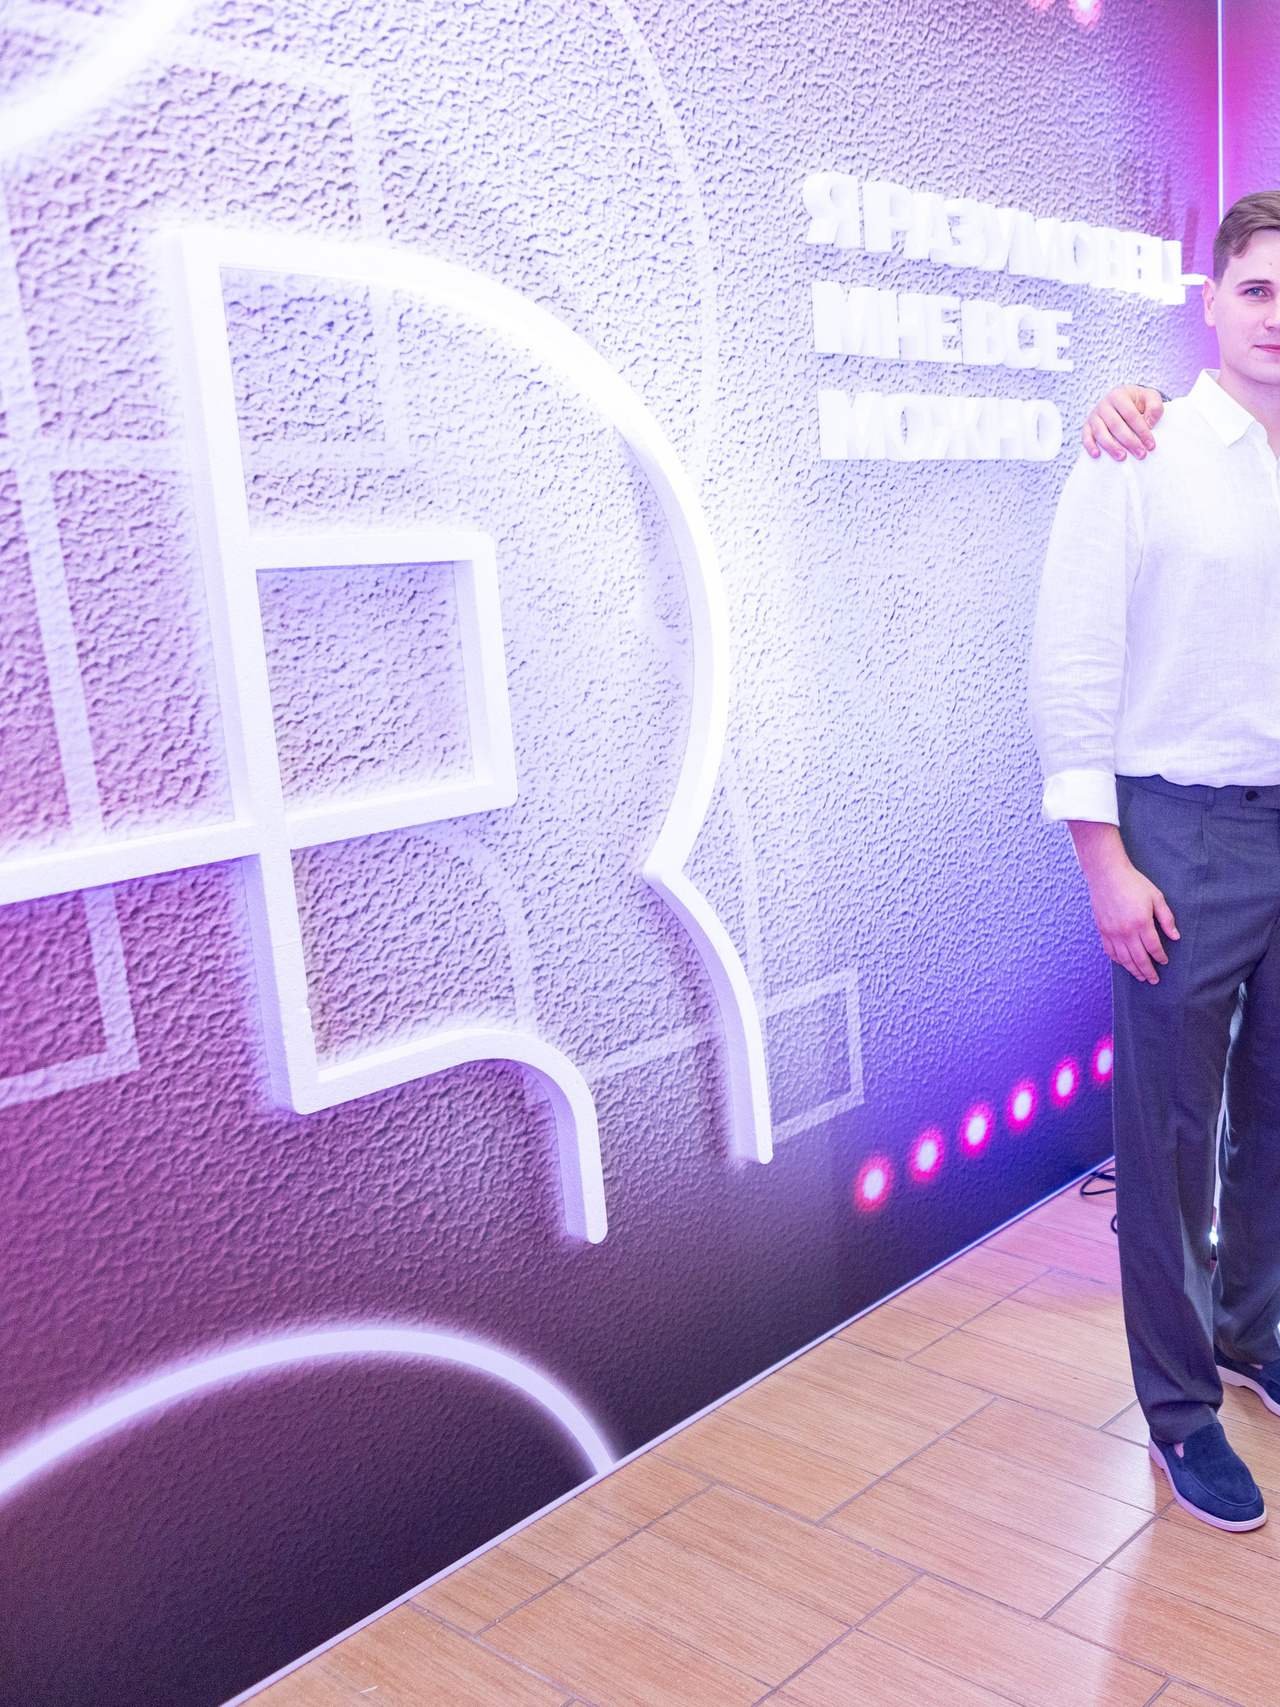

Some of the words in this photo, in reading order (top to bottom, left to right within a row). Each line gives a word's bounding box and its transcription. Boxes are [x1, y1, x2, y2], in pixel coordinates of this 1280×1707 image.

[802, 171, 861, 250] Я
[811, 281, 962, 363] МНЕ
[961, 300, 1073, 372] ВСЕ
[817, 389, 1063, 462] МОЖНО
